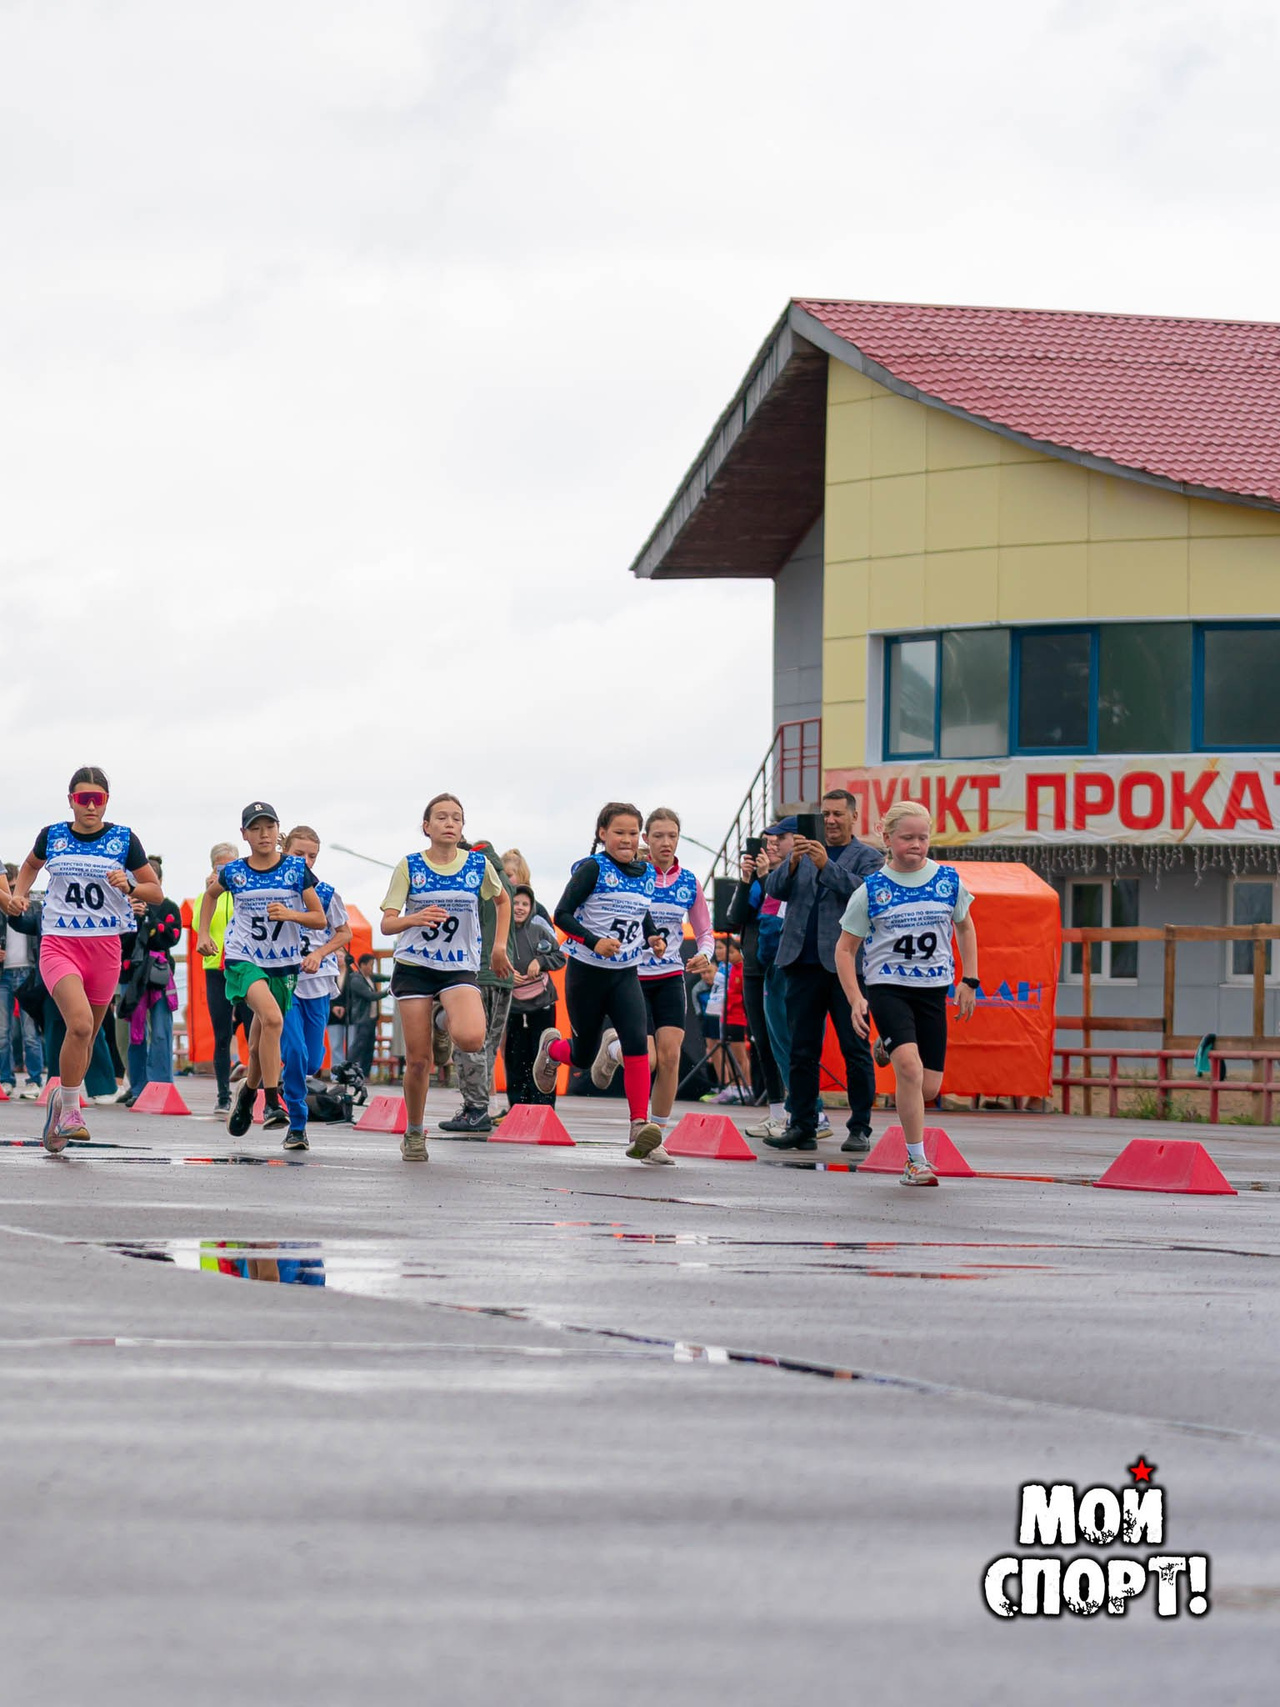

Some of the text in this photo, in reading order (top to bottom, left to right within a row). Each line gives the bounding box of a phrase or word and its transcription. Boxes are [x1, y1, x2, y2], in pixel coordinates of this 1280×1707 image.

[847, 770, 1280, 835] ПУНКТ ПРОКА
[65, 883, 104, 910] 40
[251, 917, 285, 941] 57
[421, 916, 459, 943] 39
[893, 932, 937, 960] 49
